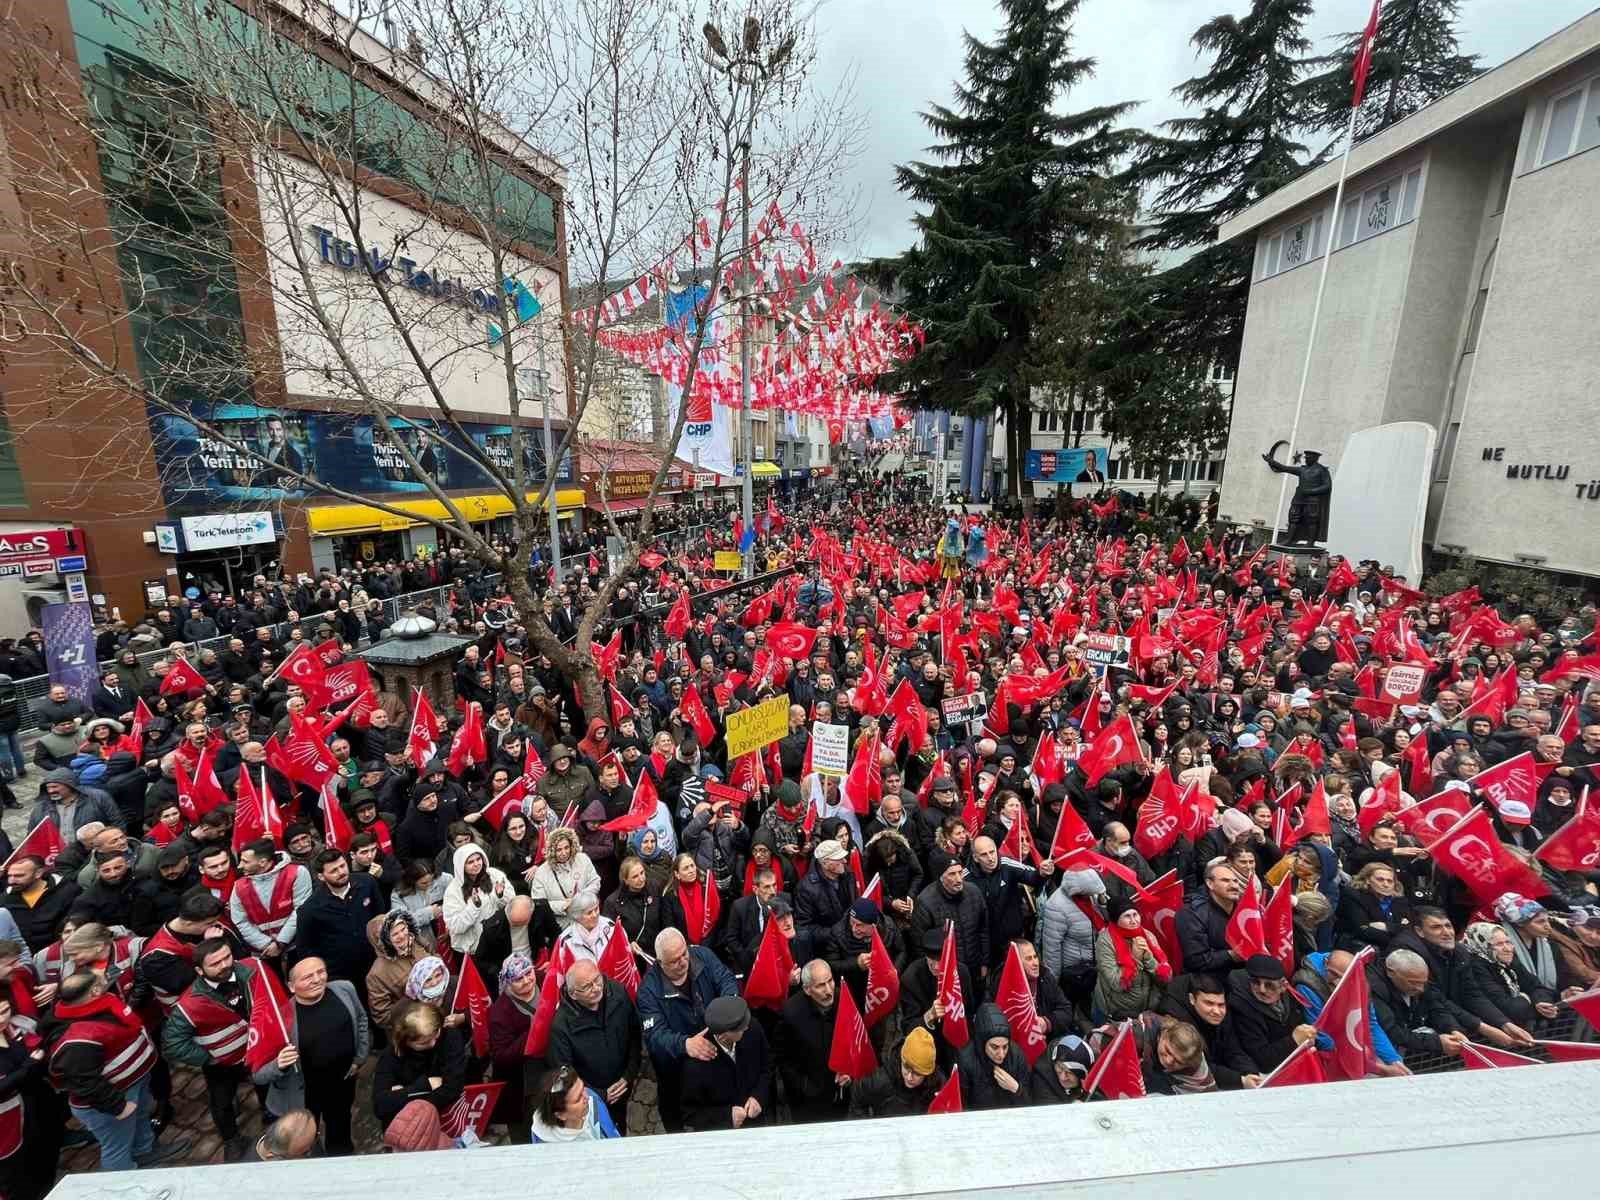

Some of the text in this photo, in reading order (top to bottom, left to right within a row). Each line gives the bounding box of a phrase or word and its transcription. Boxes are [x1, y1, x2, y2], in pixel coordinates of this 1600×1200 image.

[687, 423, 711, 436] CHP
[200, 454, 232, 469] Yeni
[1482, 448, 1504, 461] NE
[1506, 464, 1570, 480] MUTLU
[194, 525, 253, 538] Türk Telekom
[59, 644, 87, 664] +1
[332, 683, 358, 700] CHP
